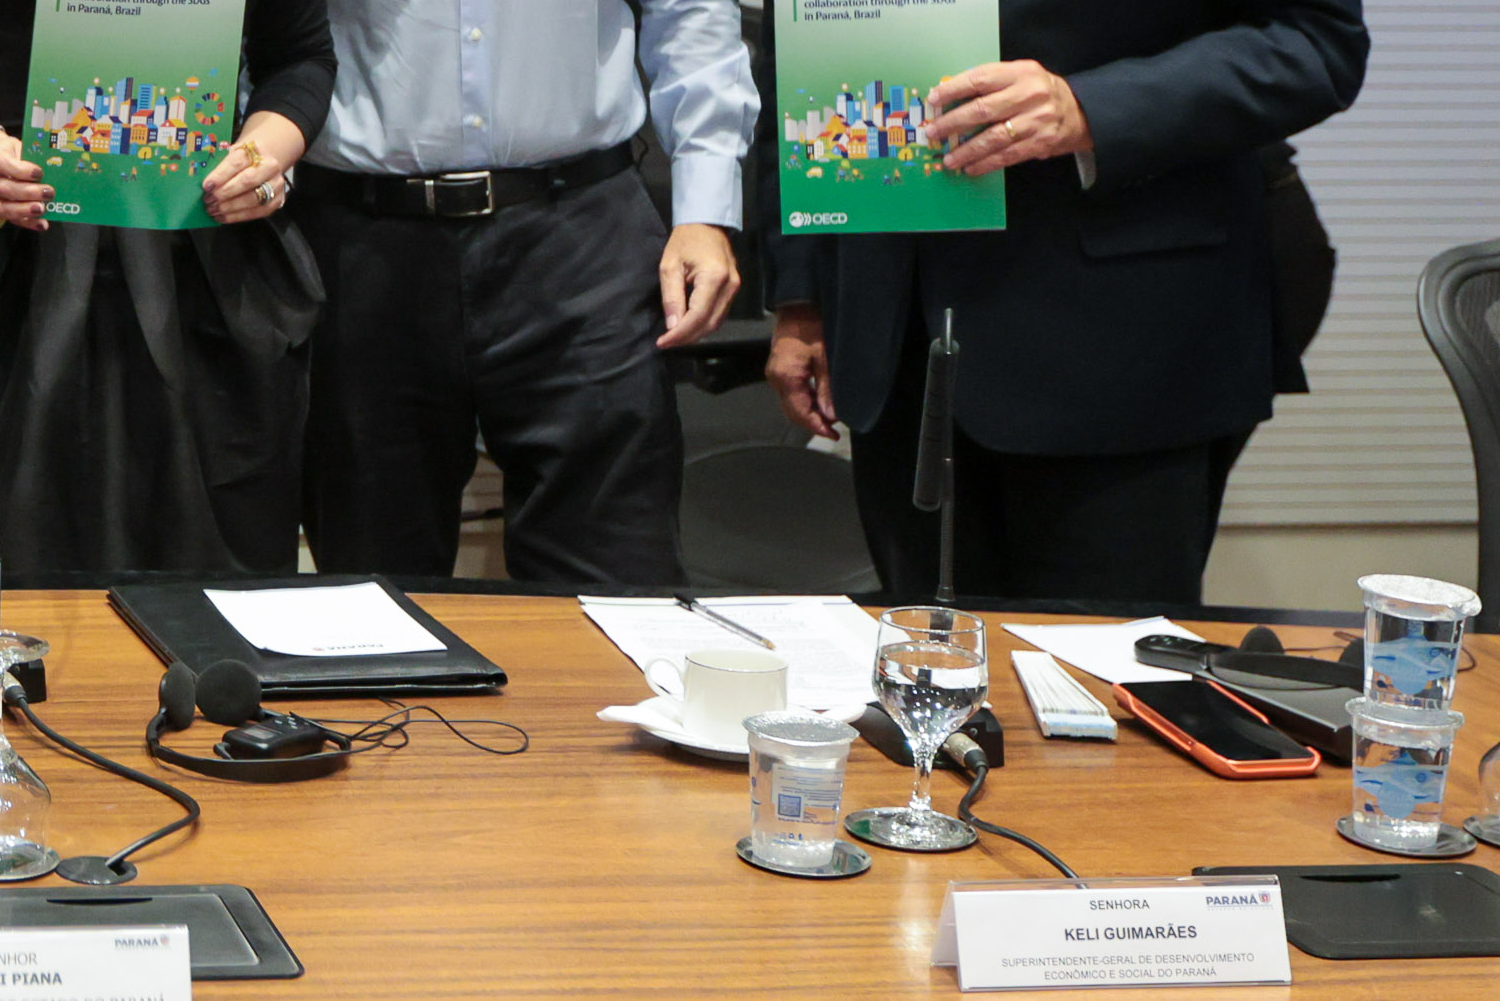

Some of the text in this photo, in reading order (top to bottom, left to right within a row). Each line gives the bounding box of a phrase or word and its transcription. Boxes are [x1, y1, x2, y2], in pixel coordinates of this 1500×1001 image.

[67, 3, 141, 16] in Paraná, Brazil
[804, 9, 881, 22] in Paraná, Brazil
[46, 202, 80, 214] OECD
[812, 212, 848, 225] OECD
[1089, 899, 1150, 911] SENHORA
[1206, 893, 1258, 905] PARANÁ
[1065, 923, 1197, 942] KELI GUIMARÃES
[1002, 953, 1254, 967] SUPERINTENDENTE-GERAL DE DESENVOLVIMENTO
[12, 972, 63, 985] PIANA
[1044, 965, 1217, 981] ECONÔMICO E SOCIAL DO PARANÁ
